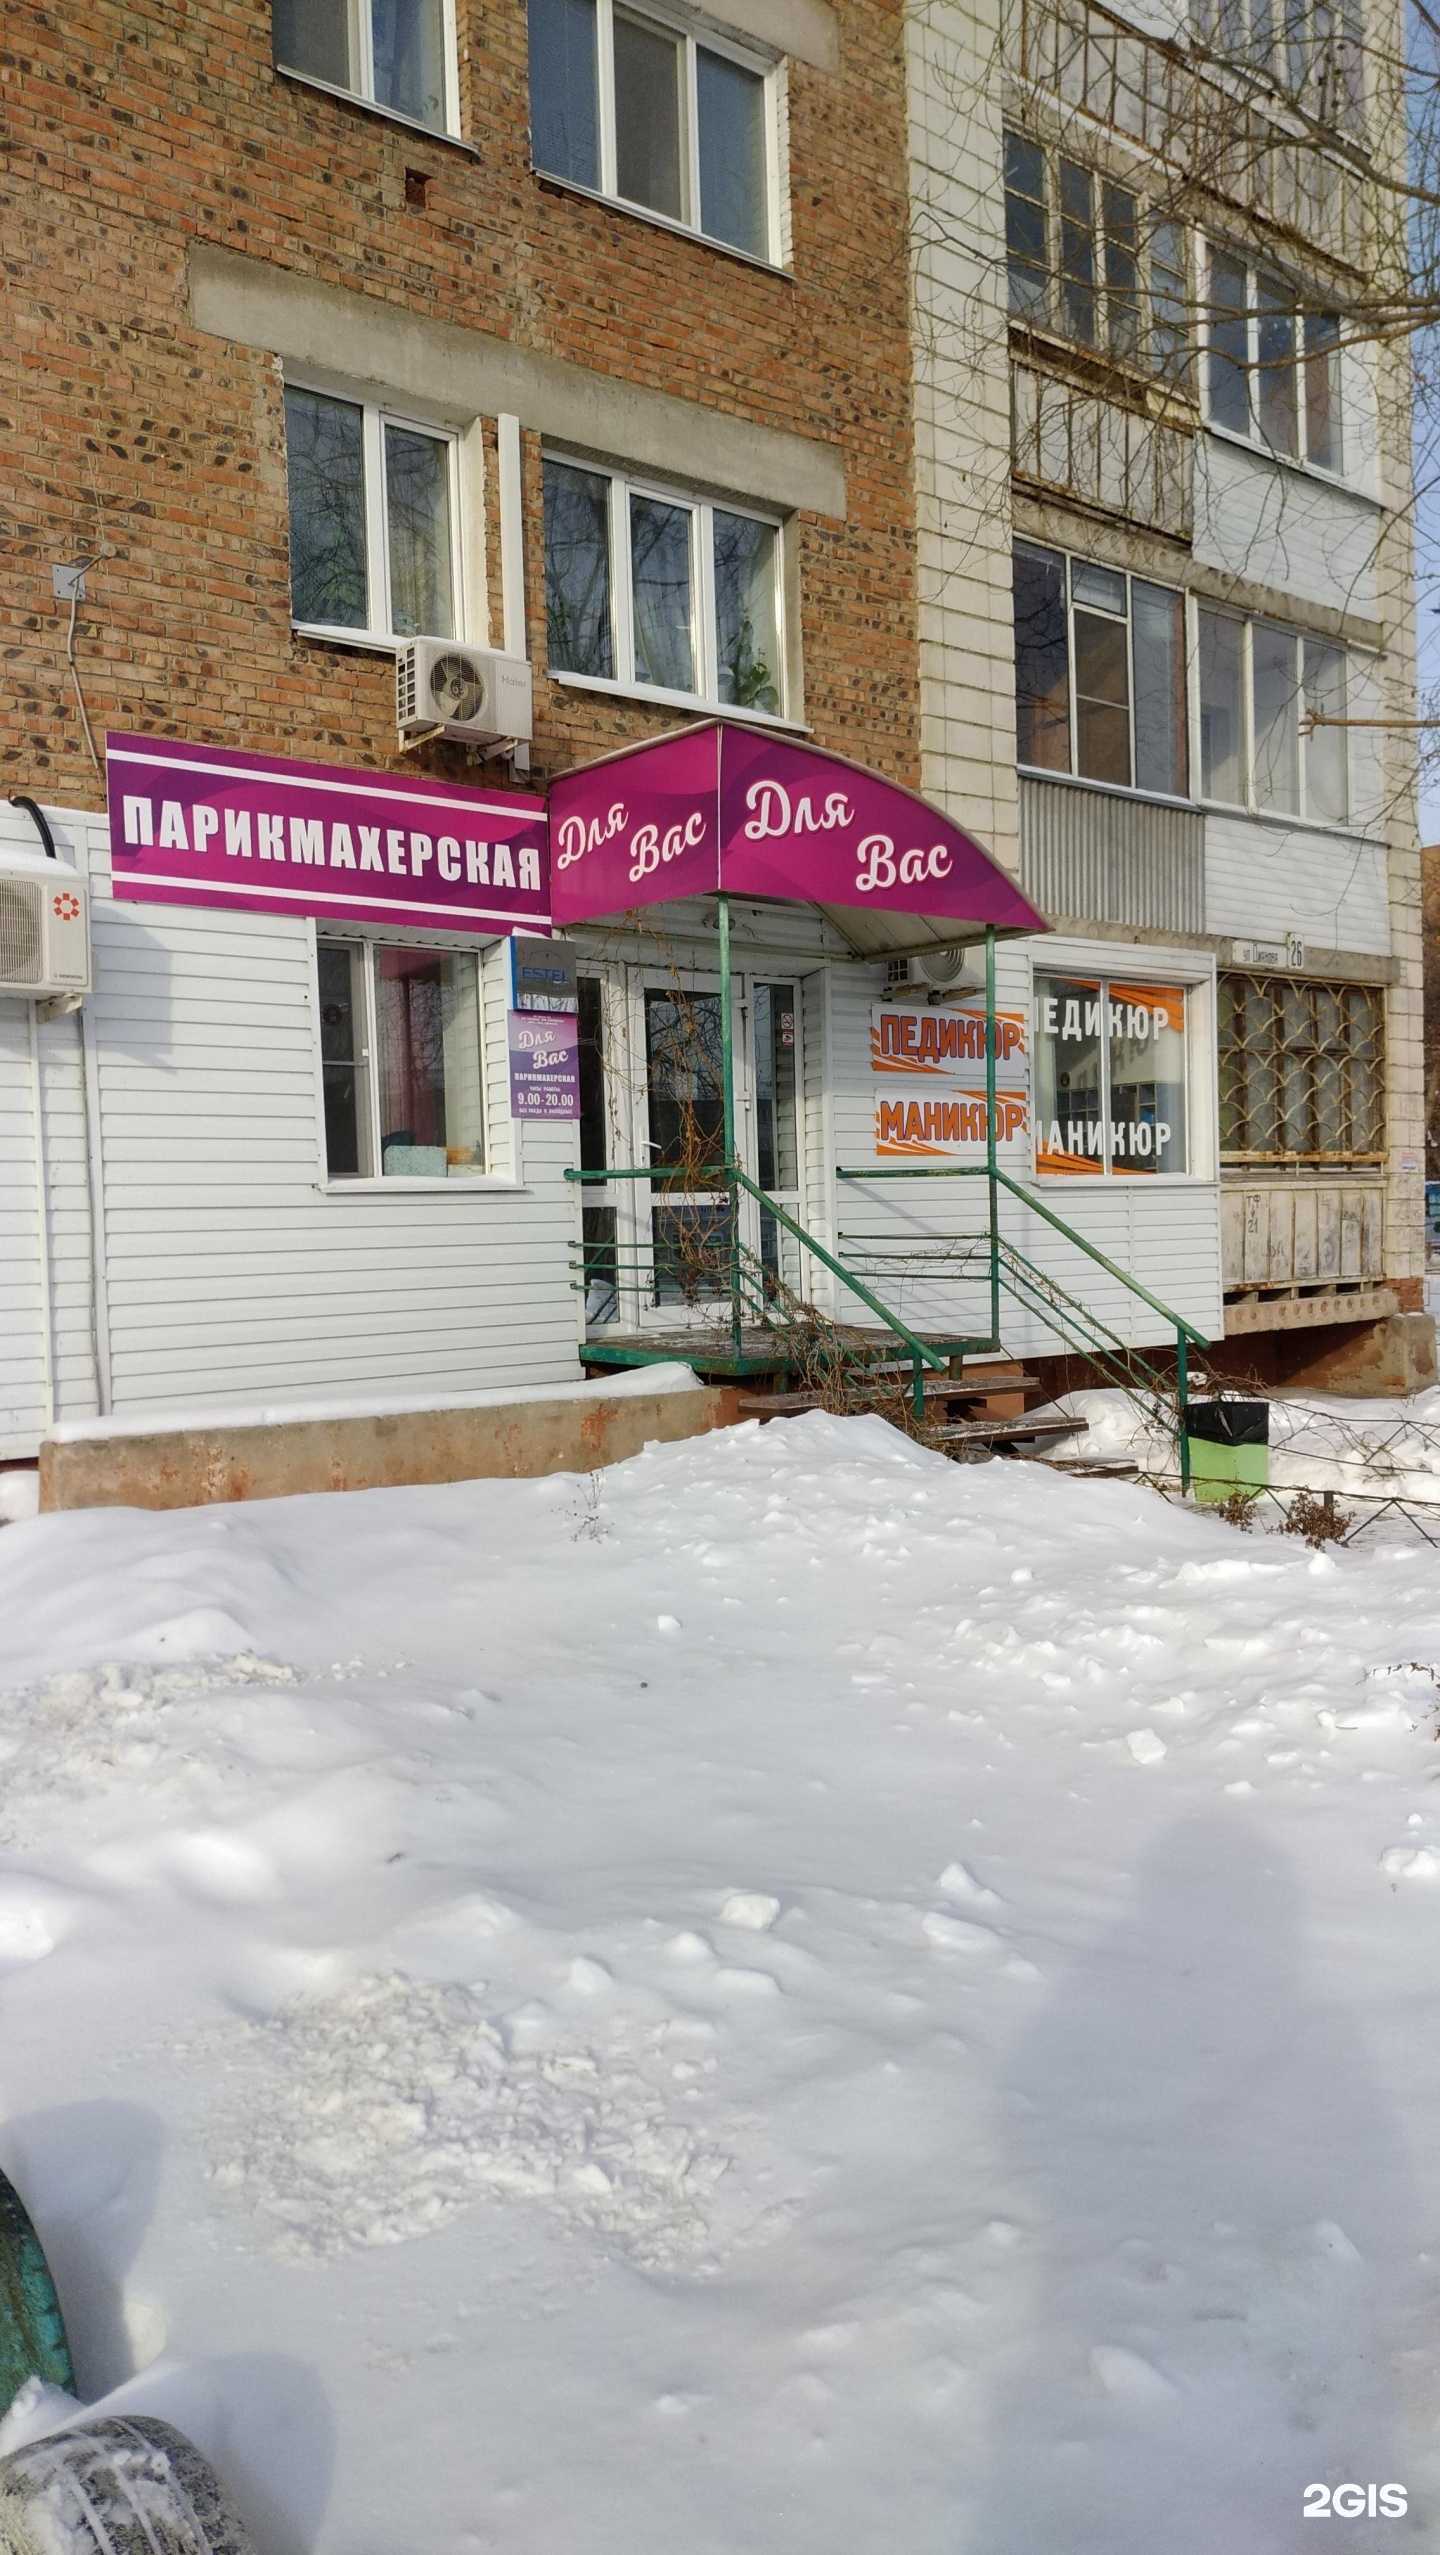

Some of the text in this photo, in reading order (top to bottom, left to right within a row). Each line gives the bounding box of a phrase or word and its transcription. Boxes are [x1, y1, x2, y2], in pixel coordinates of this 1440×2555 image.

[557, 803, 629, 870] Для
[744, 780, 855, 840] Для
[122, 795, 541, 891] ПАРИКМАХЕРСКАЯ
[629, 812, 707, 883] Вас
[855, 834, 953, 891] Вас
[522, 967, 568, 984] ESTEL
[1291, 940, 1302, 966] 26
[519, 1030, 557, 1049] Для
[532, 1050, 569, 1070] Вас
